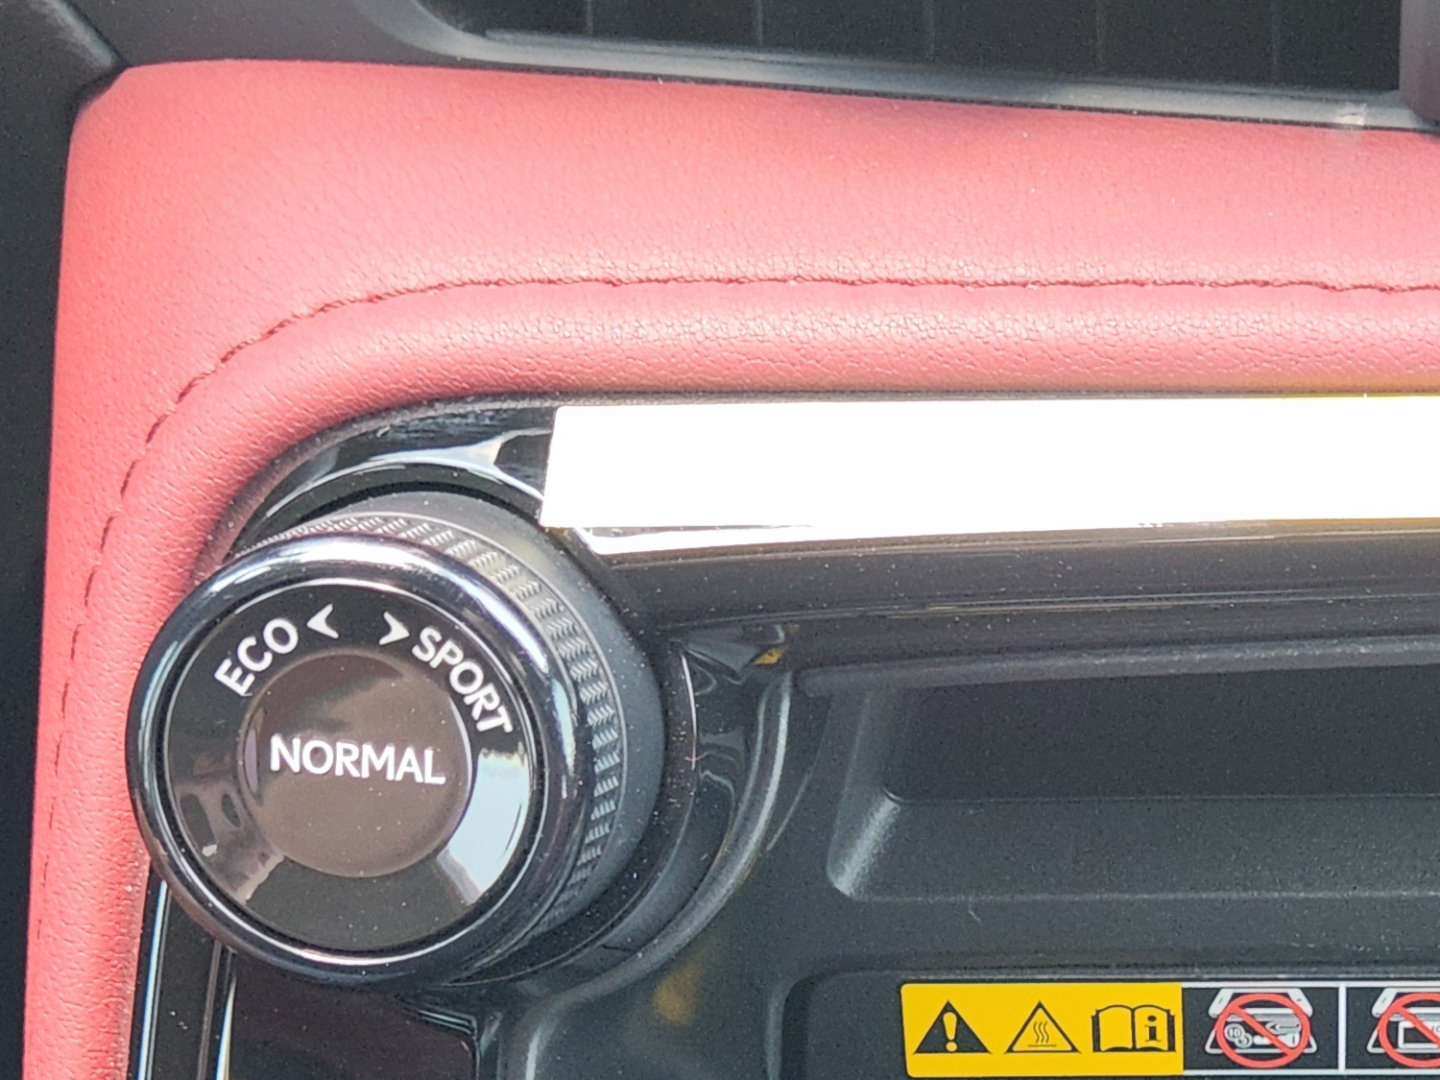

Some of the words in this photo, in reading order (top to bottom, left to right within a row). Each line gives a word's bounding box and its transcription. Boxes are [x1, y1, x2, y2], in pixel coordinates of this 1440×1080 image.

[214, 618, 299, 697] ECO
[411, 626, 514, 733] SPORT
[269, 733, 447, 786] NORMAL
